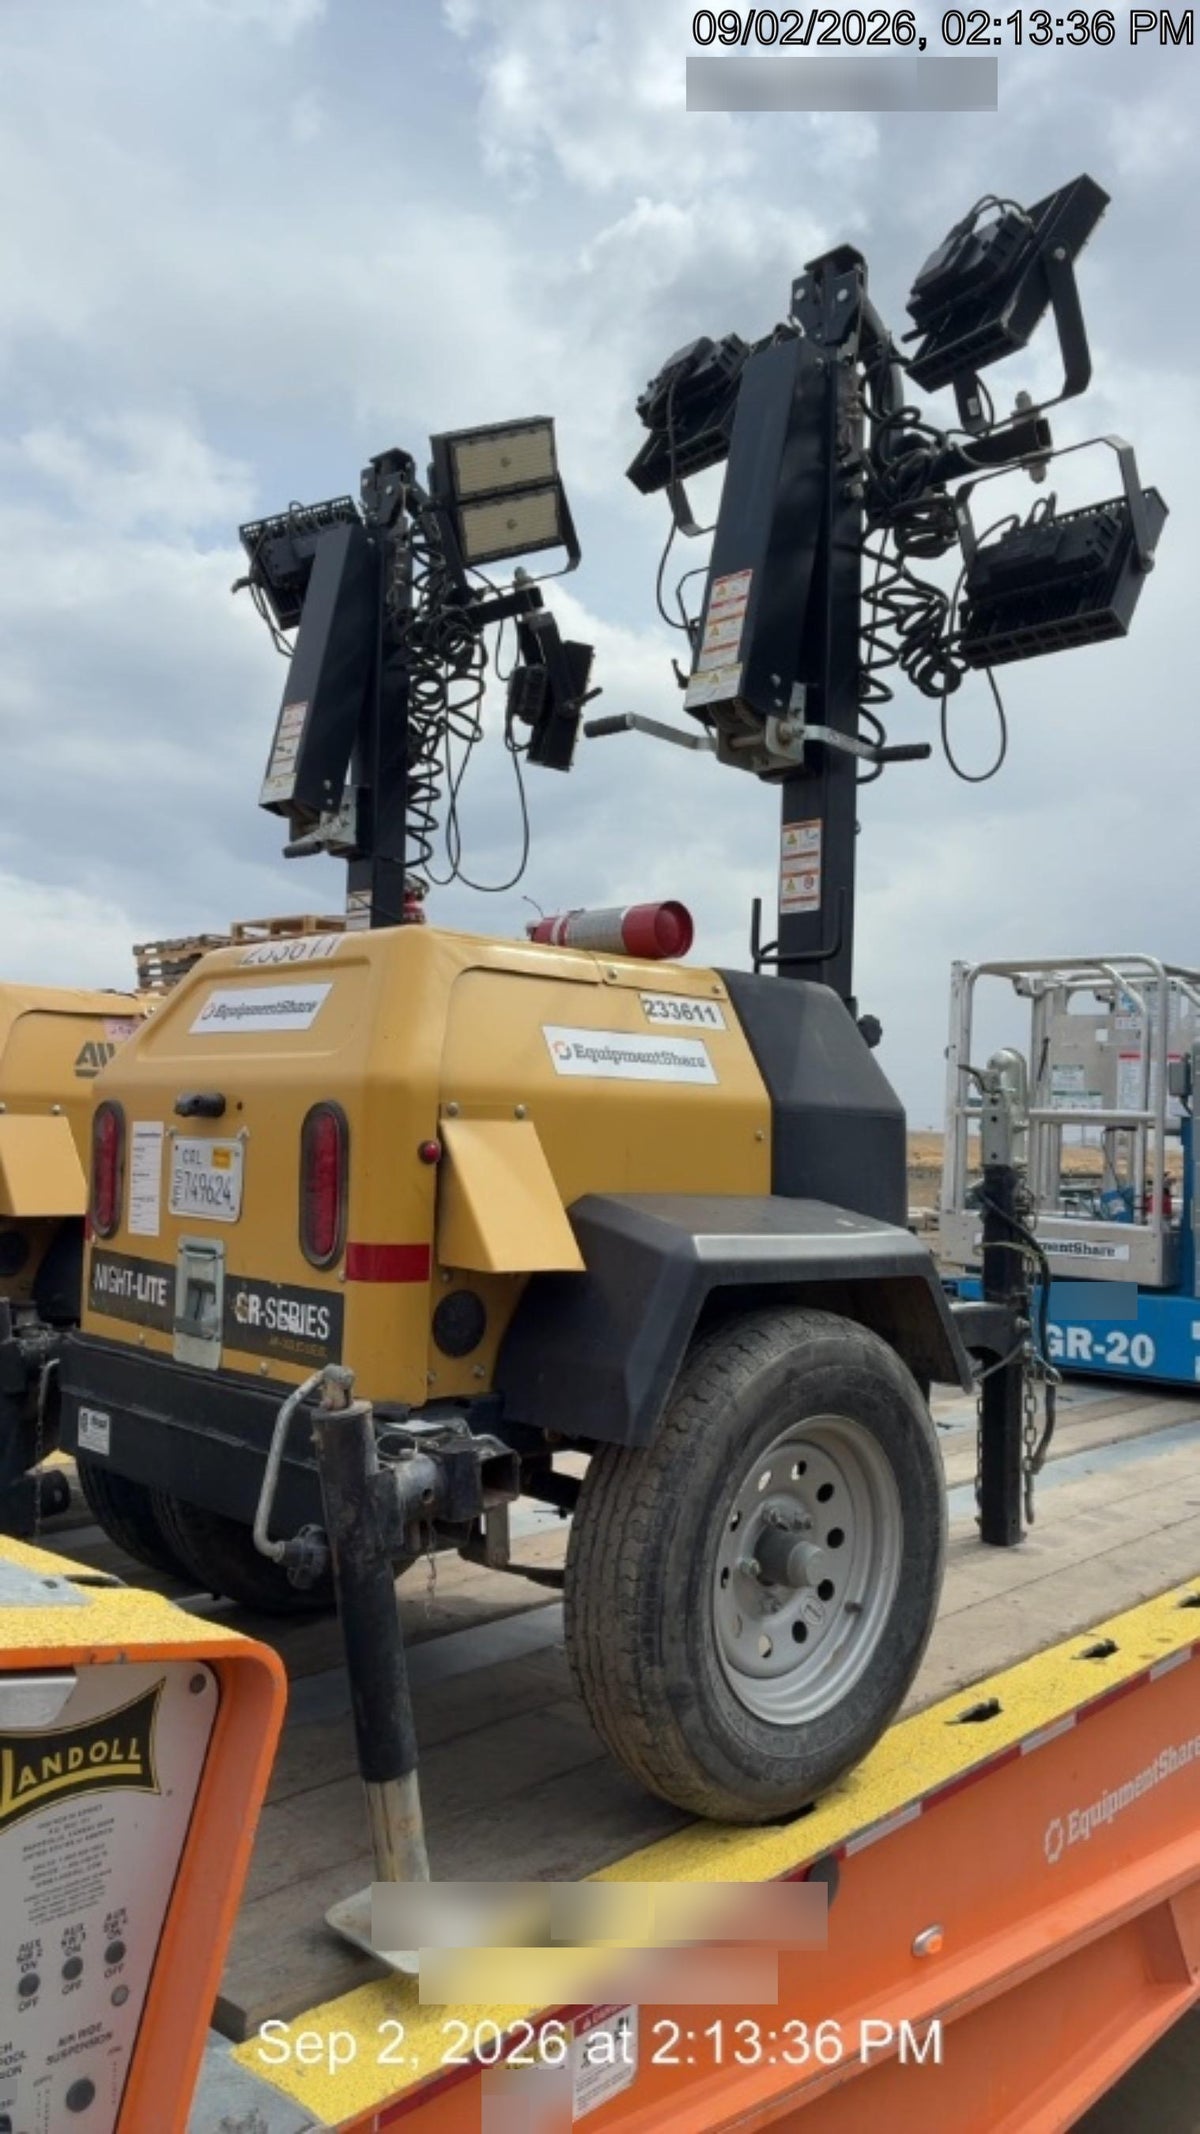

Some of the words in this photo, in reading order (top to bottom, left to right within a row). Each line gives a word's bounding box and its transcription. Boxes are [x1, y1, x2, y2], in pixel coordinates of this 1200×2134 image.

[213, 1001, 318, 1020] EquipmentShare
[642, 999, 717, 1024] 233611
[570, 1042, 707, 1068] EquipmentShare
[1041, 1242, 1116, 1258] mentShare
[93, 1262, 168, 1308] NIGHT-LITE
[1046, 1322, 1156, 1368] GR-20
[0, 1738, 143, 1819] LANDOLL
